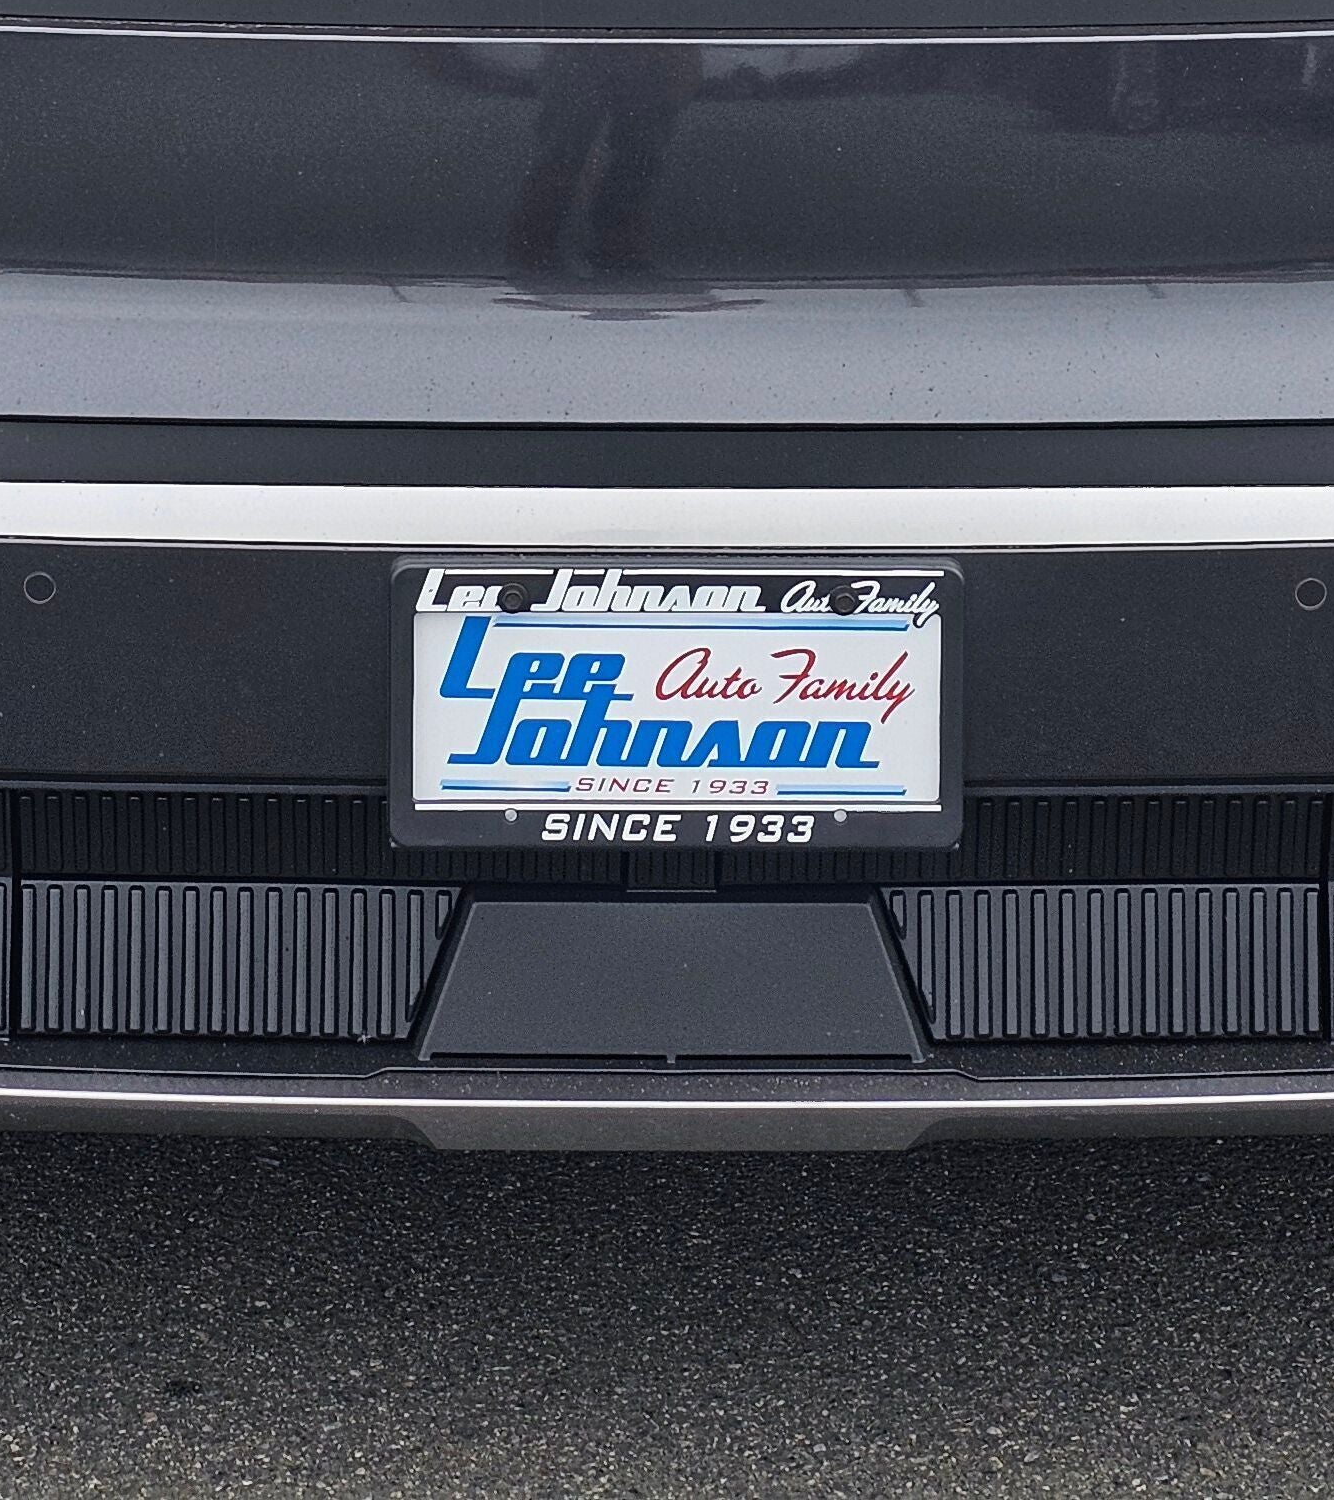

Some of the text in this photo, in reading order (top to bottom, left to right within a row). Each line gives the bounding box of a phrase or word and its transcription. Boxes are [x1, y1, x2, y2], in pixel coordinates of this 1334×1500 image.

[530, 568, 766, 612] Johnson
[780, 580, 834, 613] Aut
[850, 579, 940, 628] Family
[440, 616, 633, 700] Lee
[655, 647, 916, 724] Auto Family
[447, 698, 880, 768] Johnson
[575, 776, 771, 796] SINCE 1933
[541, 813, 815, 843] SINCE 1933
